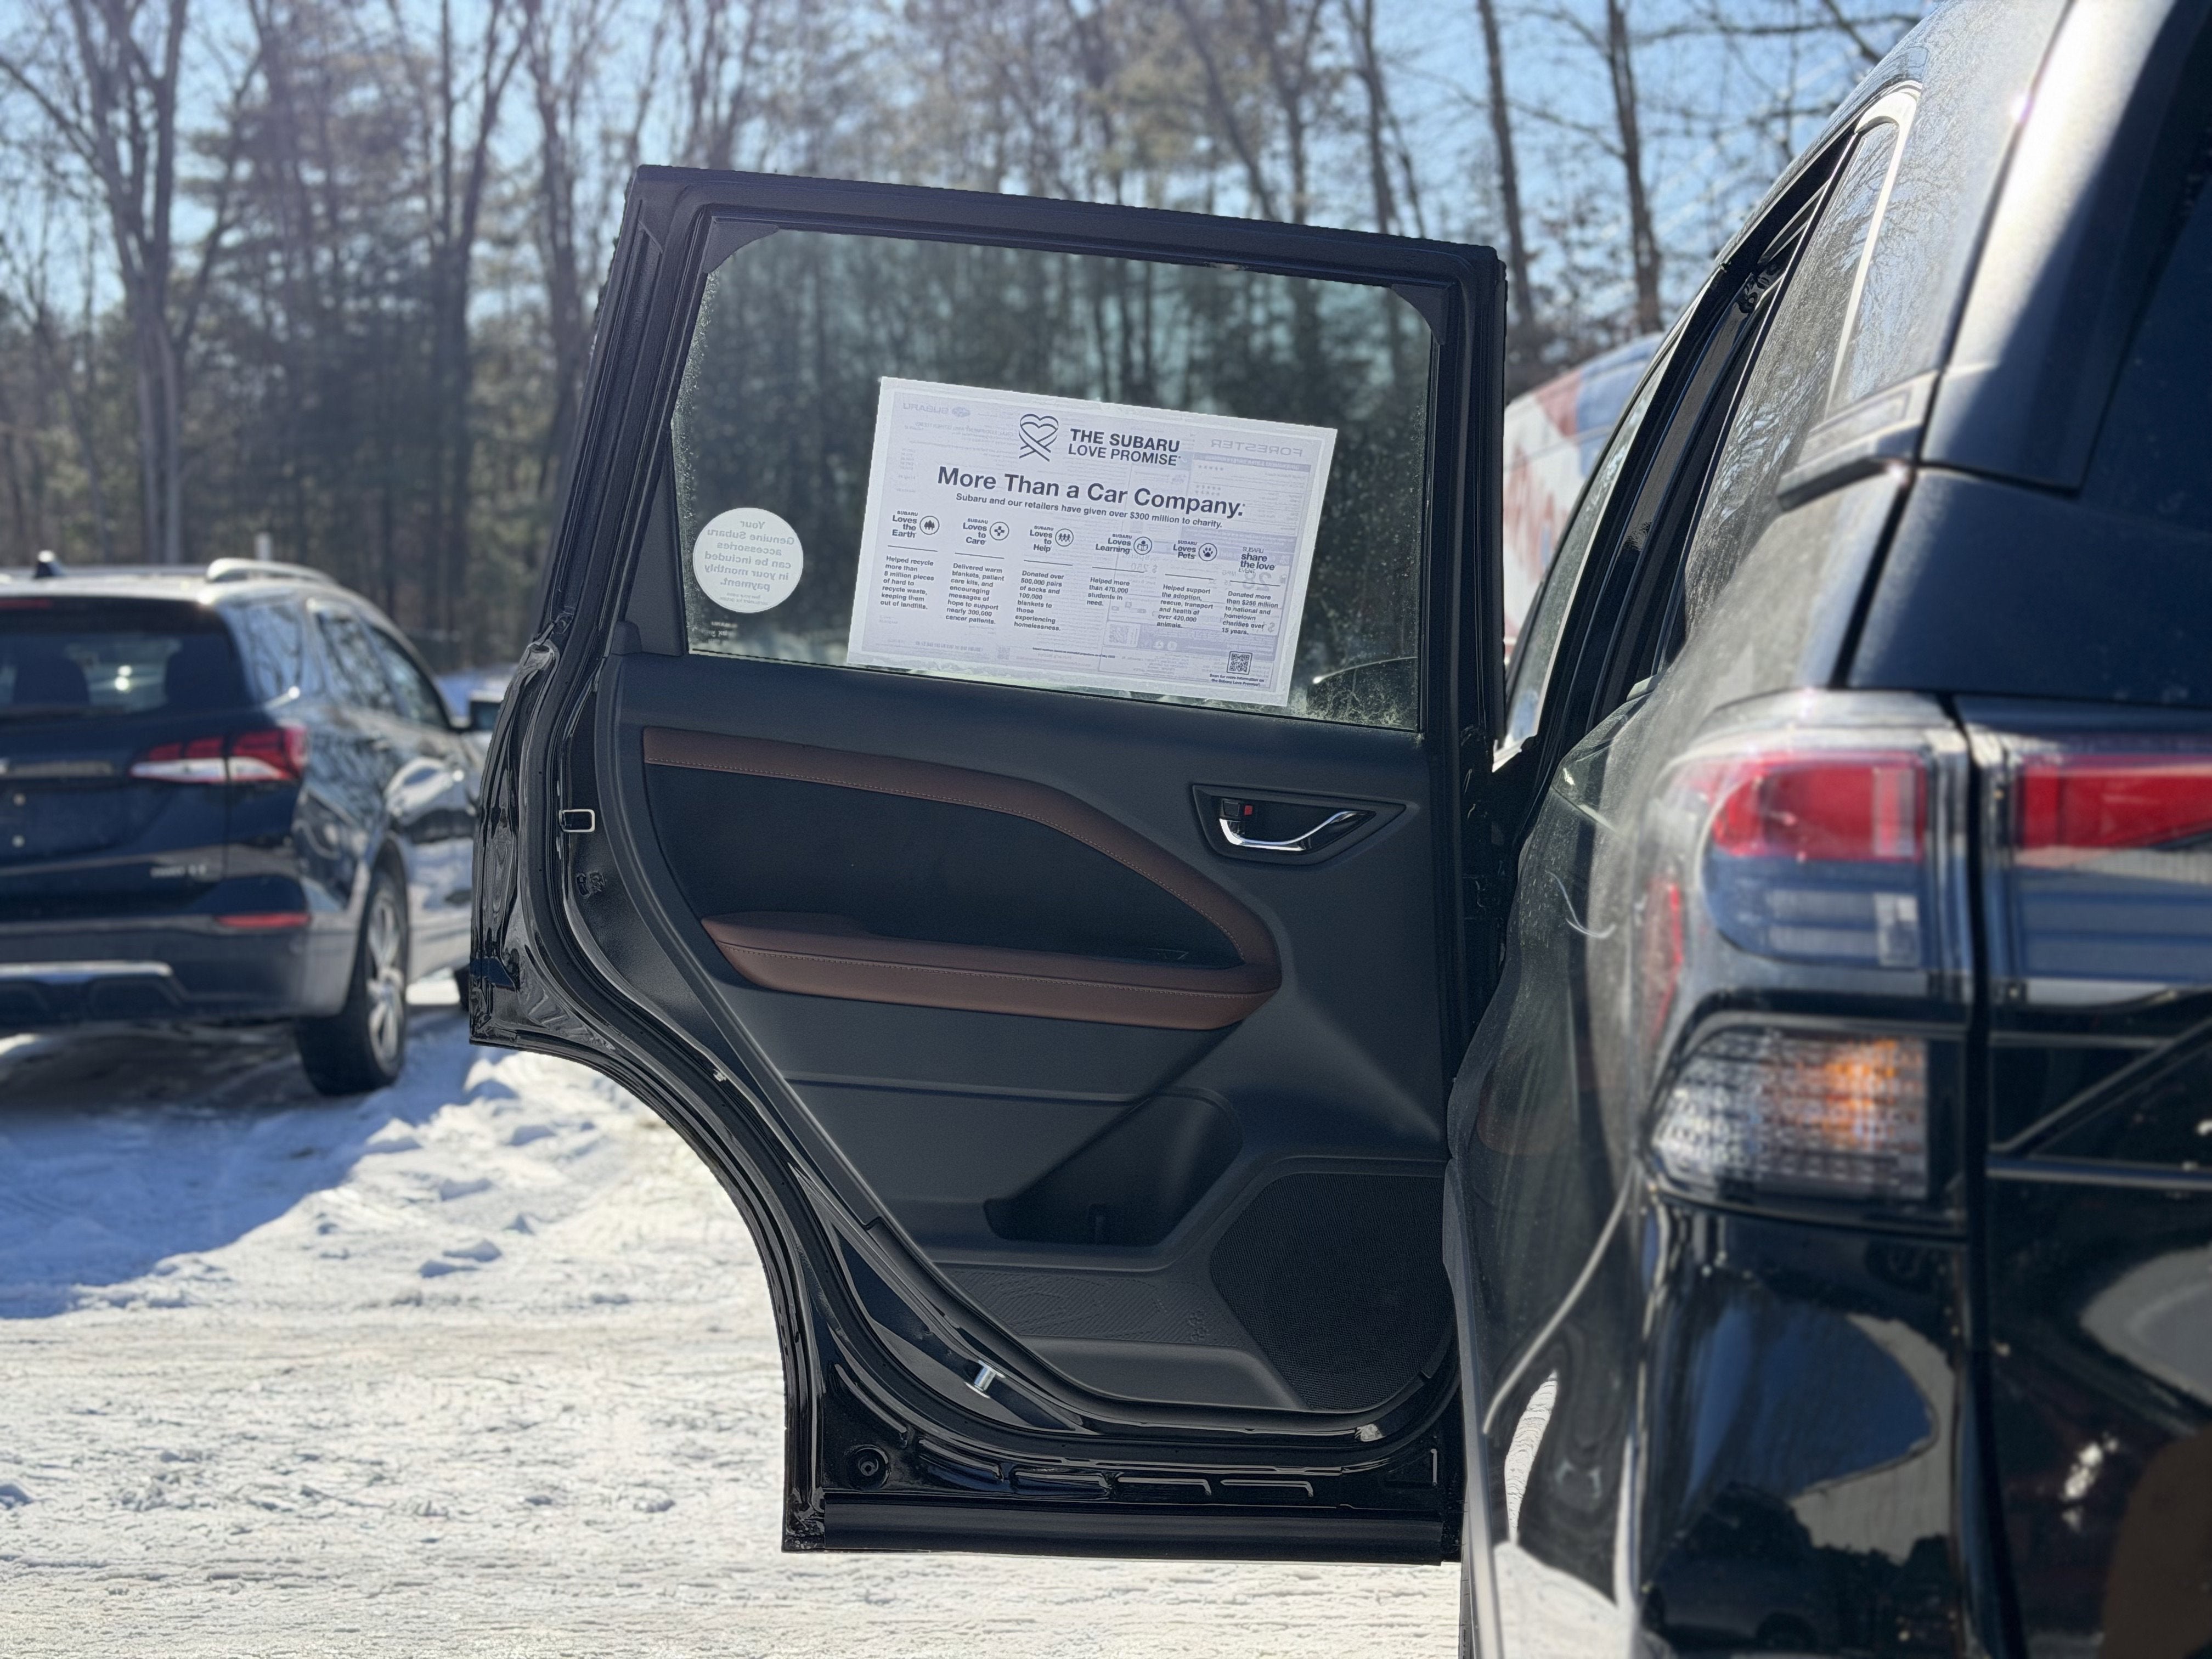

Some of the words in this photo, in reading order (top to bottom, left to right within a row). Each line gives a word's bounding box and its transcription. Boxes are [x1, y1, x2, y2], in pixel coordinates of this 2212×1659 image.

[1070, 428, 1104, 444] THE
[1109, 433, 1180, 453] SUBARU
[1068, 443, 1107, 458] LOVE
[938, 466, 996, 489] More
[1005, 473, 1059, 496] Than
[1066, 485, 1079, 499] a
[1087, 483, 1128, 503] Car
[956, 493, 987, 503] Subaru
[1024, 501, 1059, 511] retailers
[1061, 504, 1081, 513] have
[1084, 507, 1107, 516] given
[1130, 511, 1149, 520] $300
[1152, 515, 1180, 523] million
[1193, 518, 1222, 529] charity.
[892, 515, 917, 524] Loves
[963, 522, 987, 532] Loves
[1030, 529, 1053, 538] Loves
[1108, 538, 1131, 546] Loves
[1173, 544, 1196, 552] Loves
[886, 555, 909, 563] Helped
[1241, 552, 1267, 562] share
[953, 563, 983, 571] Delivered
[1240, 560, 1255, 569] the
[952, 571, 980, 579] blankets,
[1022, 570, 1049, 578] Donated
[950, 586, 990, 596] encouraging
[881, 592, 907, 601] keeping
[949, 593, 981, 601] messages
[1173, 593, 1202, 602] adoption,
[1015, 615, 1056, 624] experiencing
[1224, 612, 1256, 620] hometown
[1014, 621, 1060, 631] homelessness.
